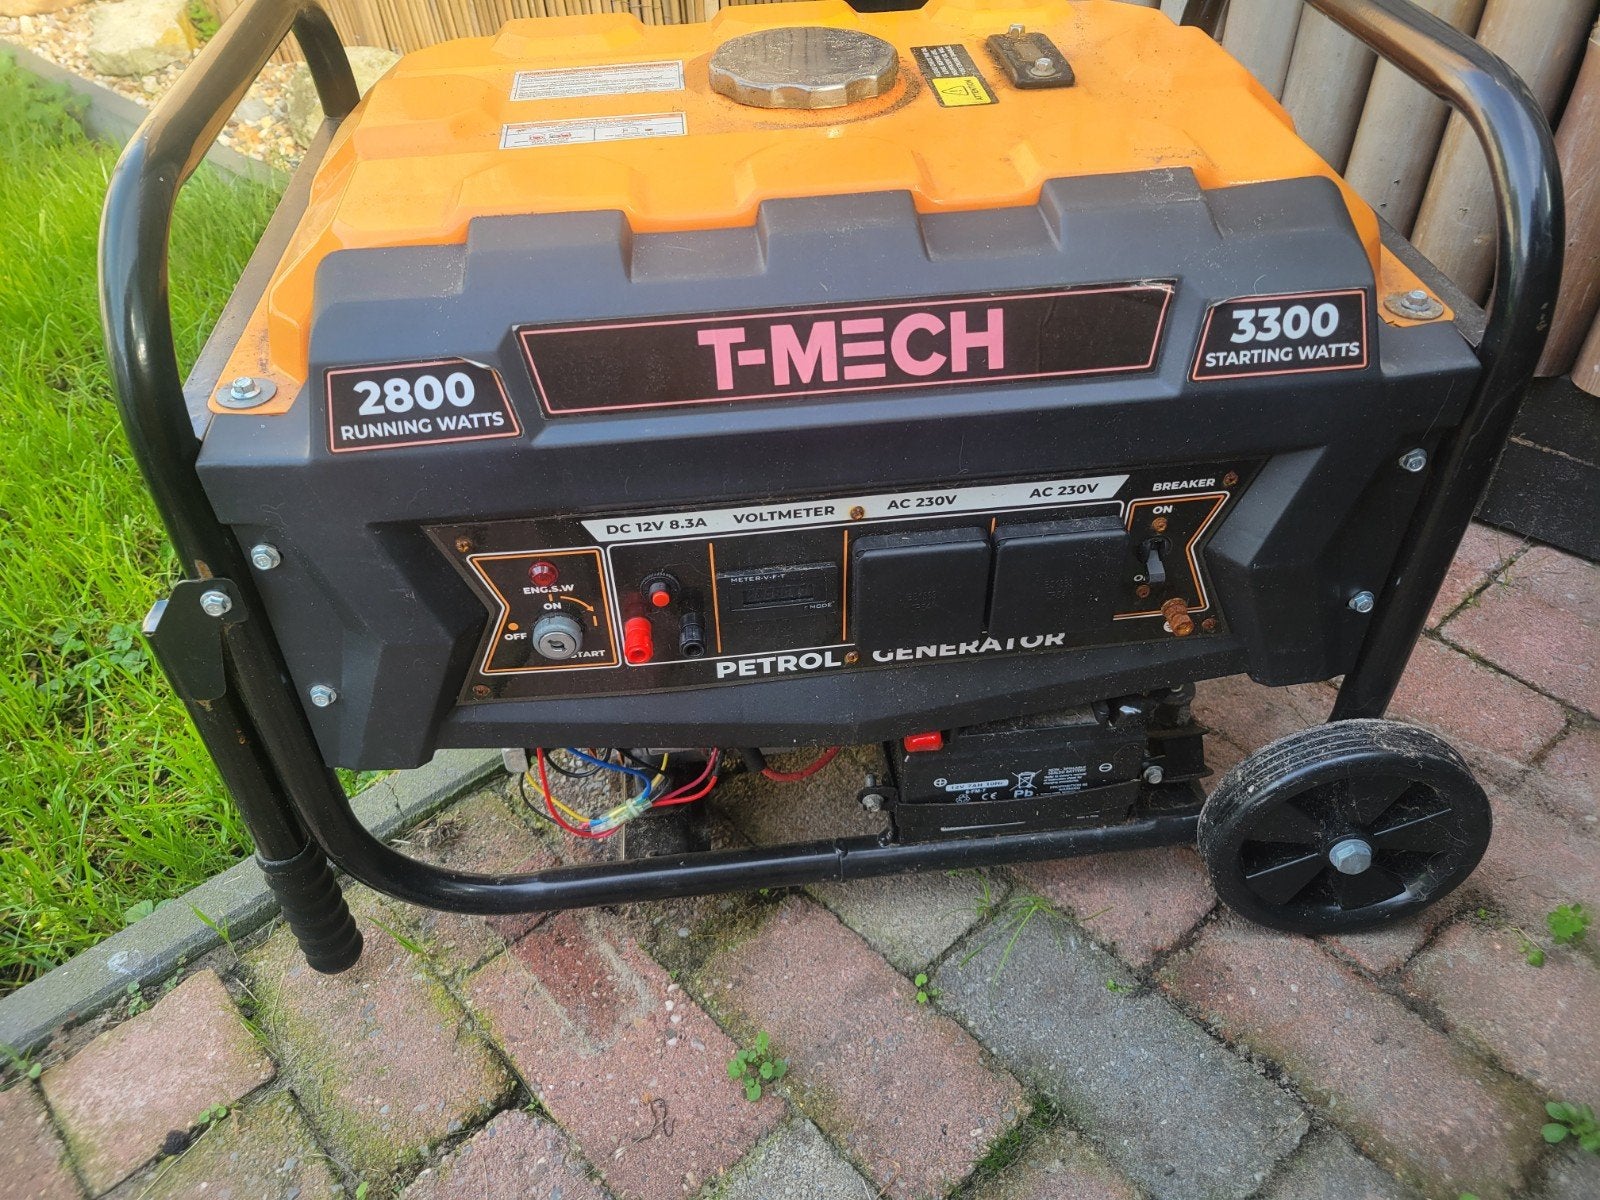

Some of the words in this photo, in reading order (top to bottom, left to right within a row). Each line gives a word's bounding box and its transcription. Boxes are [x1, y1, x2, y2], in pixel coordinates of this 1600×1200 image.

[1230, 302, 1339, 344] 3300
[697, 308, 1004, 391] T-MECH
[1205, 346, 1293, 368] STARTING
[1298, 341, 1360, 361] WATTS
[353, 371, 475, 416] 2800
[340, 418, 433, 441] RUNNING
[436, 411, 505, 432] WATTS
[1029, 487, 1053, 499] AC
[1057, 483, 1099, 497] 230V
[1152, 478, 1216, 492] BREAKER
[887, 498, 910, 510] AC
[915, 494, 957, 508] 230V
[1152, 505, 1173, 515] ON
[733, 505, 835, 524] VOLTMETER
[606, 523, 631, 535] DC
[636, 520, 664, 533] 12V
[669, 517, 707, 530] 8.3A
[523, 584, 574, 595] ENG.S.W
[543, 602, 562, 611] ON
[504, 632, 527, 641] OFF
[716, 651, 842, 679] PETROL
[1013, 789, 1034, 798] Pb
